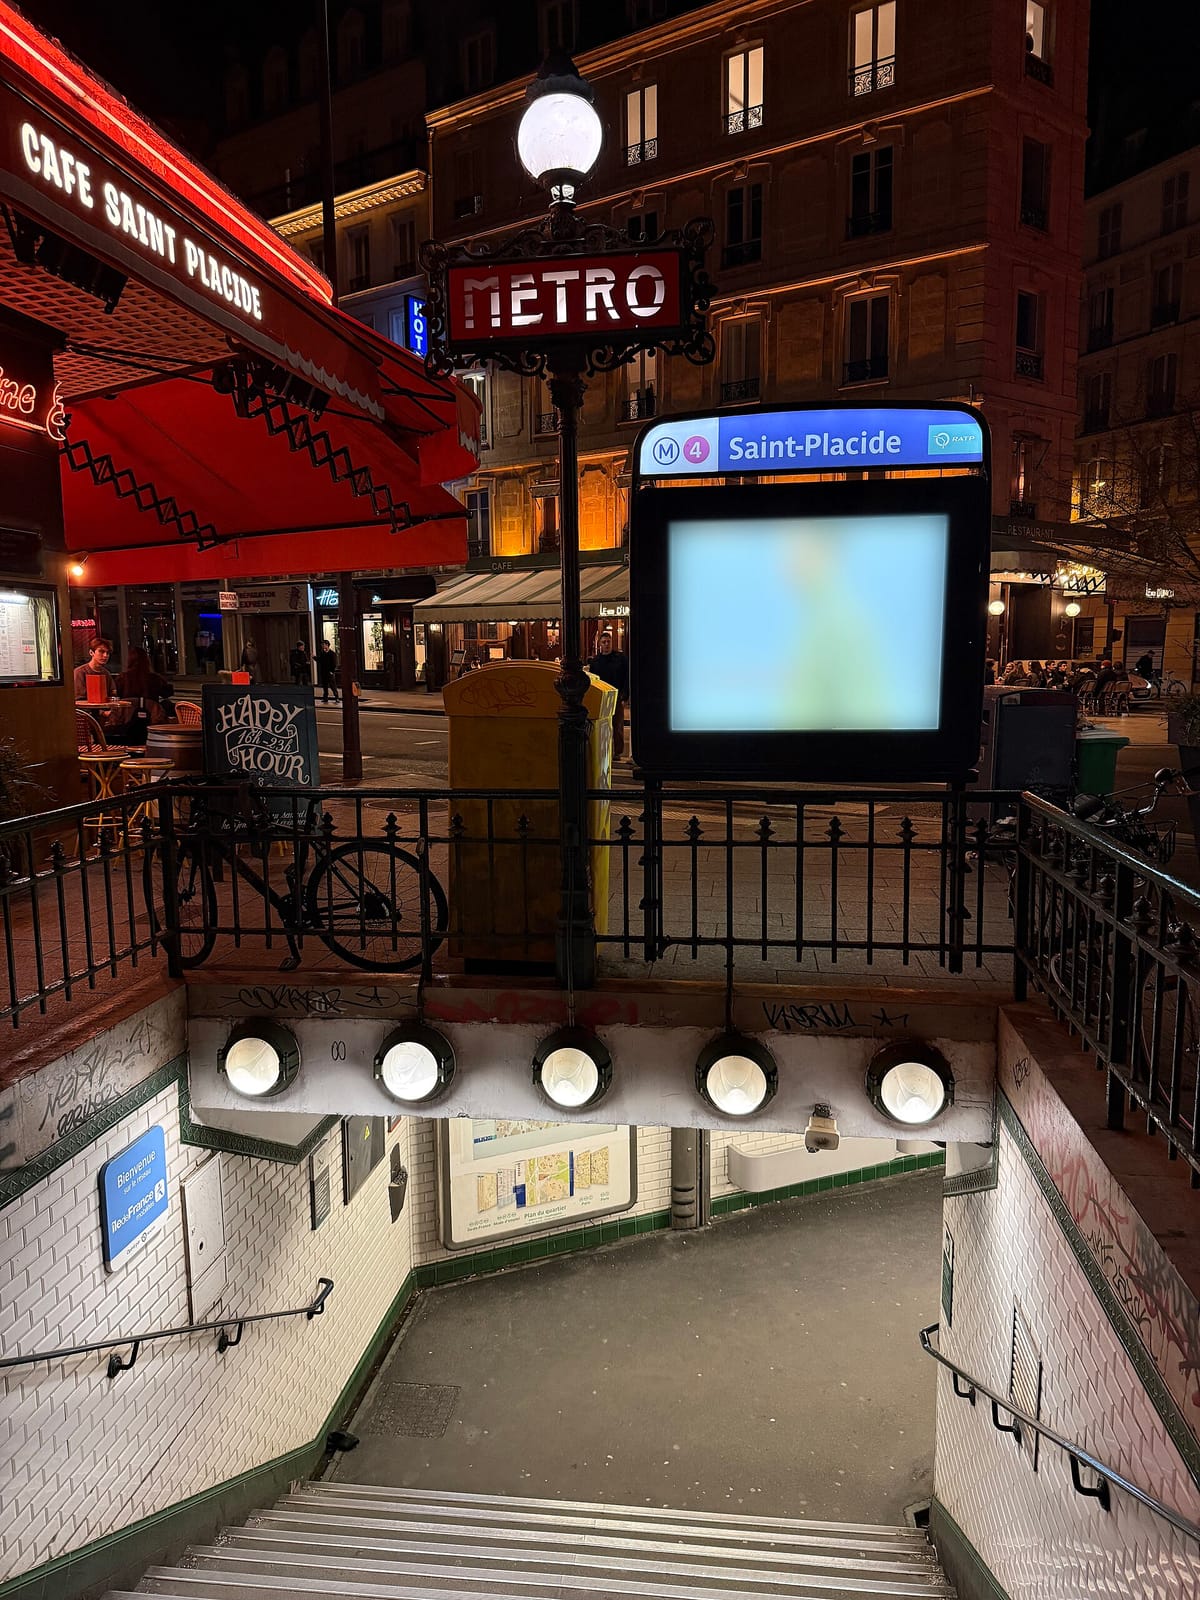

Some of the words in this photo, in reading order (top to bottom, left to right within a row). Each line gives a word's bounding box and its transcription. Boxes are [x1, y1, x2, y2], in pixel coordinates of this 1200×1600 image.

[21, 122, 94, 209] CAFE
[104, 182, 176, 264] SAINT
[184, 238, 263, 321] PLACIDE
[463, 264, 666, 329] METRO
[728, 429, 902, 461] Saint-Placide
[951, 433, 977, 443] RATP
[1007, 524, 1055, 539] RESTAURANT
[491, 561, 513, 571] CAFE
[216, 694, 304, 733] HAPPY
[240, 747, 309, 784] HOUR
[116, 1150, 157, 1189] Bienvenue
[523, 1211, 537, 1220] Plan
[545, 1204, 568, 1216] quartier
